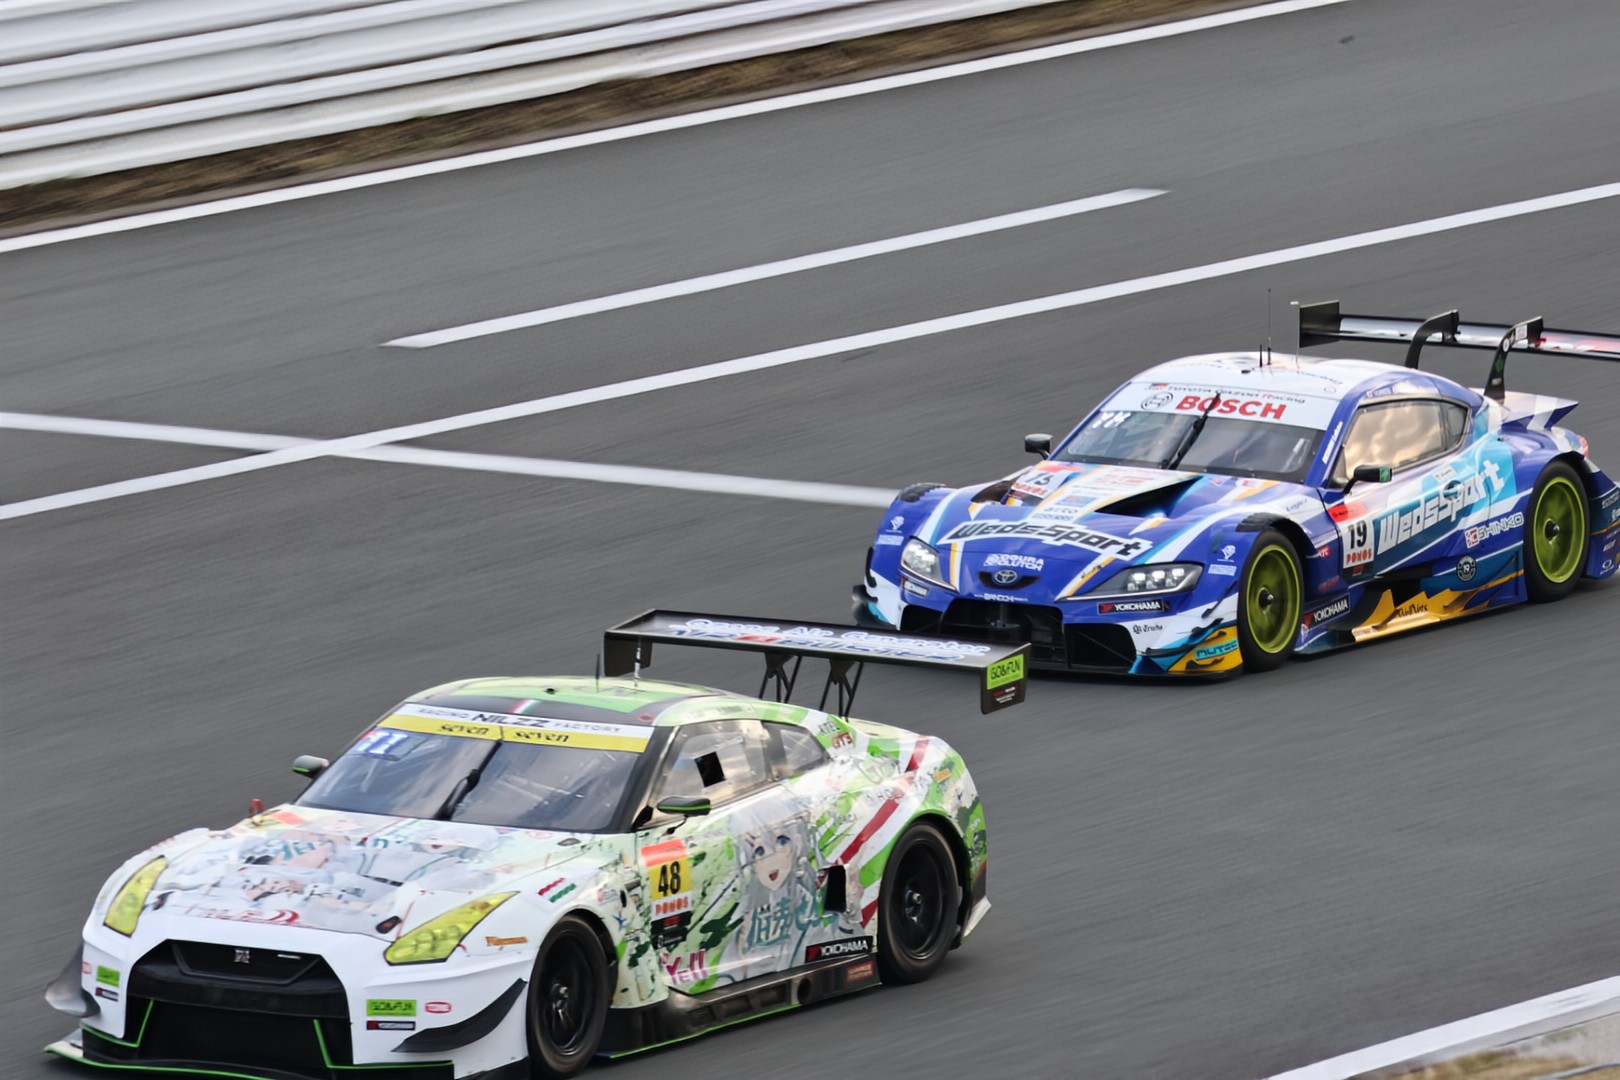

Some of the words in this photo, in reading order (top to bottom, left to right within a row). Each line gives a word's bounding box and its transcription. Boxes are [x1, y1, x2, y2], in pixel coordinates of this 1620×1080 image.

[1175, 394, 1287, 420] BOSCH
[1376, 459, 1505, 556] WedsSport
[1347, 520, 1368, 550] 19
[1478, 512, 1524, 541] SHINKO
[948, 522, 1142, 557] WedsSport
[1346, 548, 1372, 565] PONOS
[1114, 601, 1161, 611] YOKOHAMA
[1313, 599, 1349, 623] YOKOHAMA
[991, 660, 1020, 680] GO&FUN
[472, 713, 550, 728] NILZZ
[658, 861, 681, 897] 48
[655, 896, 689, 916] PONOS
[820, 939, 869, 957] YOKOHAMA
